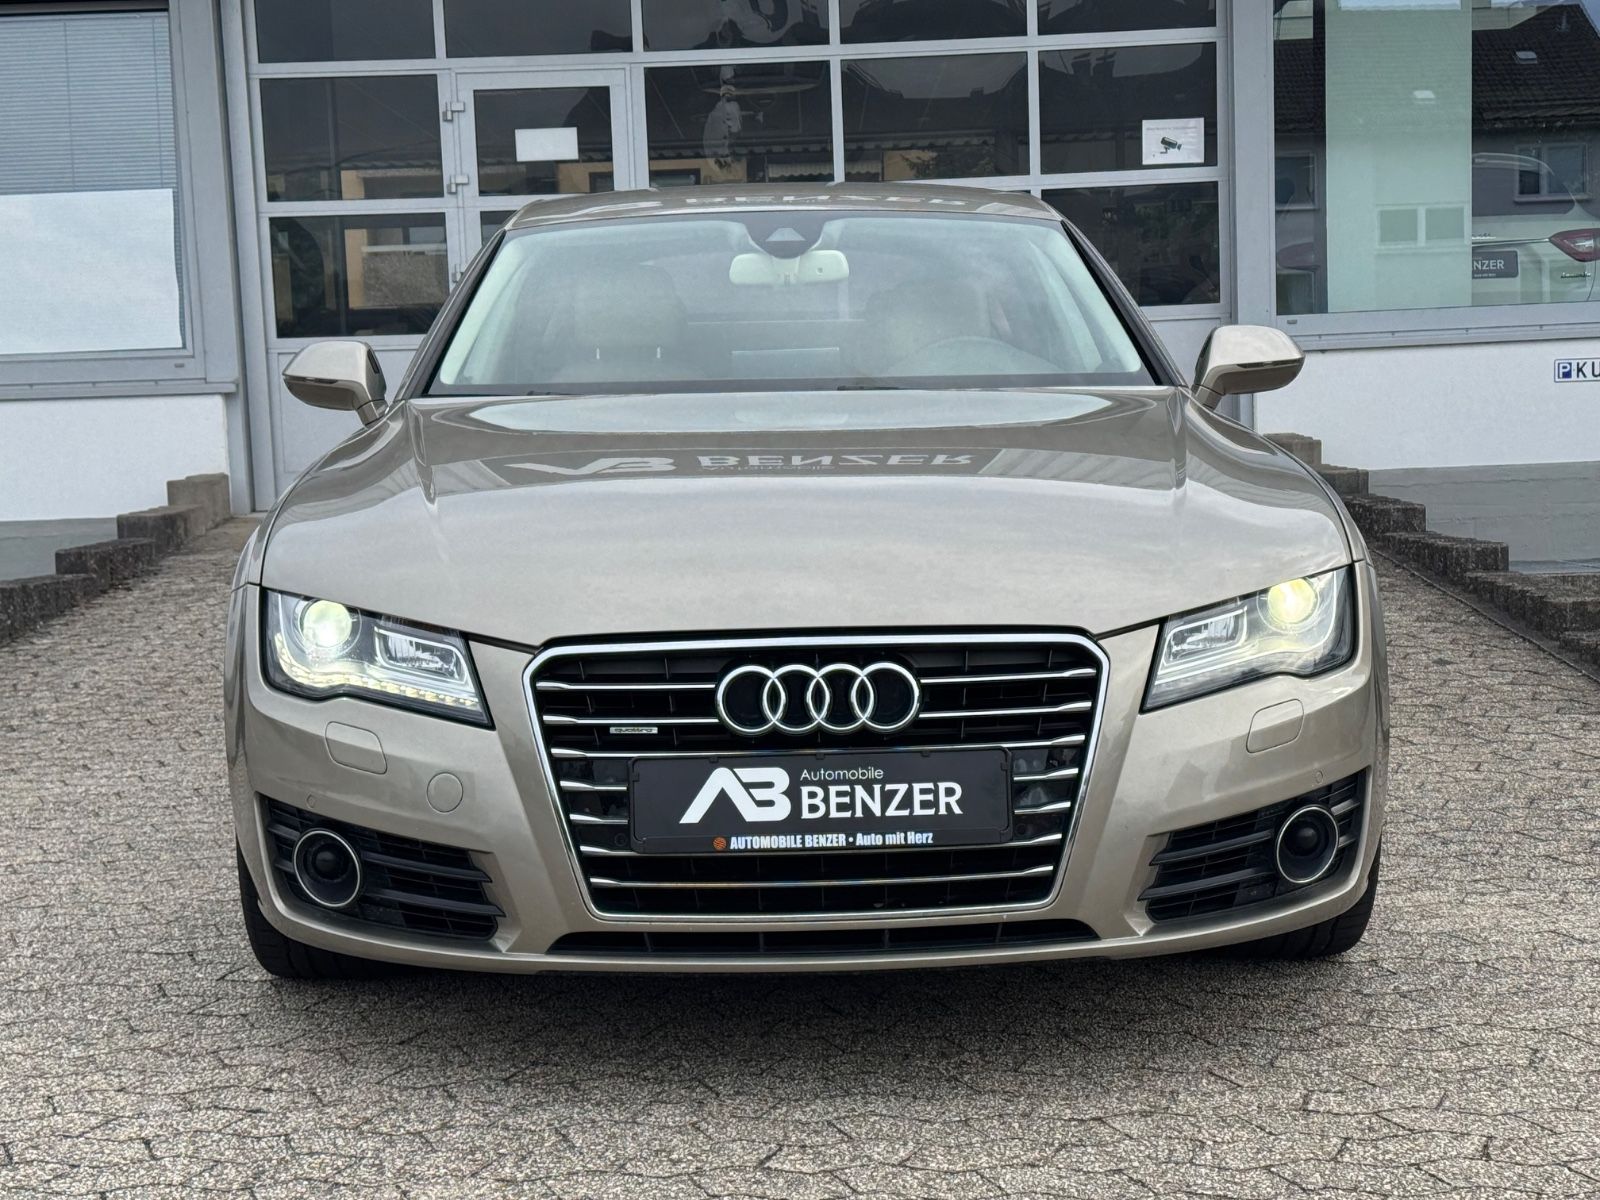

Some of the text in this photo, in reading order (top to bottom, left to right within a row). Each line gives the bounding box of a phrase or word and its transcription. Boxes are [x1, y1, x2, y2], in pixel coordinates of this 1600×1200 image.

[1472, 259, 1505, 271] NZER
[800, 766, 884, 781] Automobile
[800, 781, 963, 819] BENZER
[730, 831, 934, 850] AUTOMOBILE BENZER Auto mit Herz
